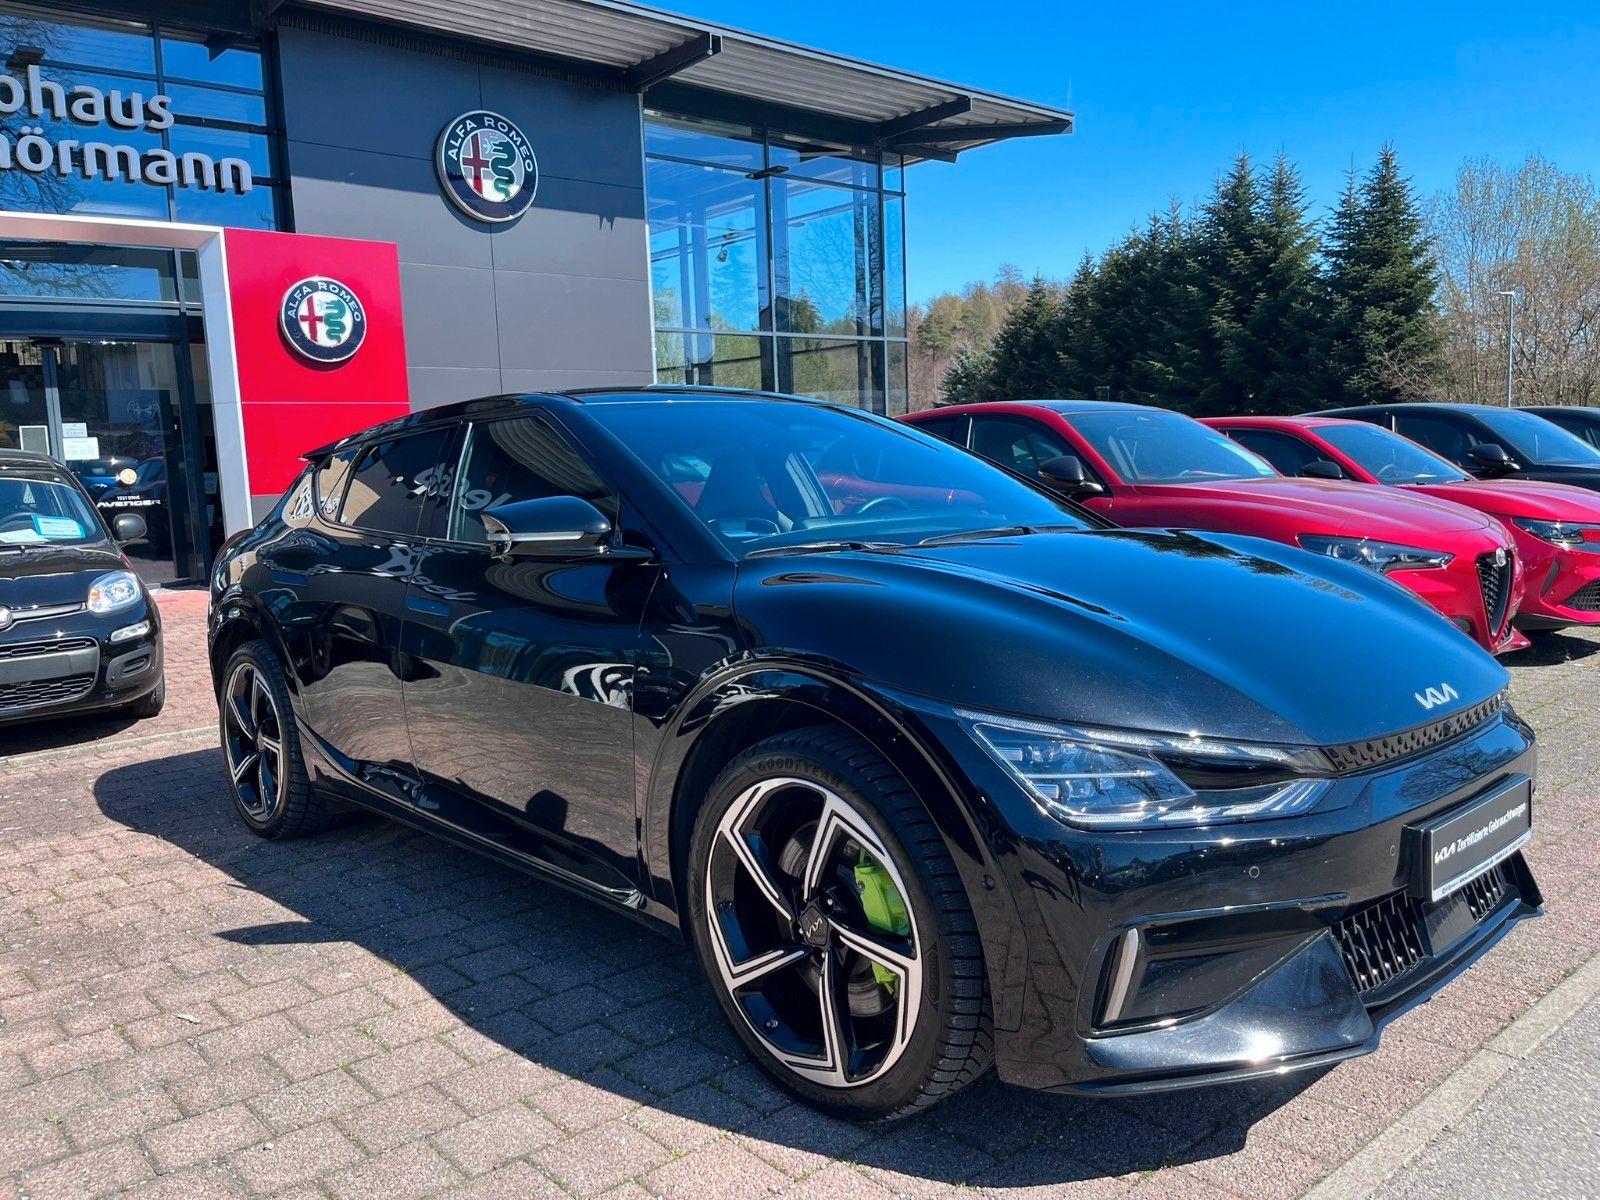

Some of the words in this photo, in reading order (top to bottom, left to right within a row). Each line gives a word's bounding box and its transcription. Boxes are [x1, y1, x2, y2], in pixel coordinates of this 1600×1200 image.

[447, 119, 477, 161] ALFA
[484, 116, 534, 172] ROMEO
[287, 285, 313, 319] ALFA
[317, 281, 362, 322] ROMEO
[96, 499, 162, 508] AVENGER
[1457, 826, 1490, 852] Zertifizierte
